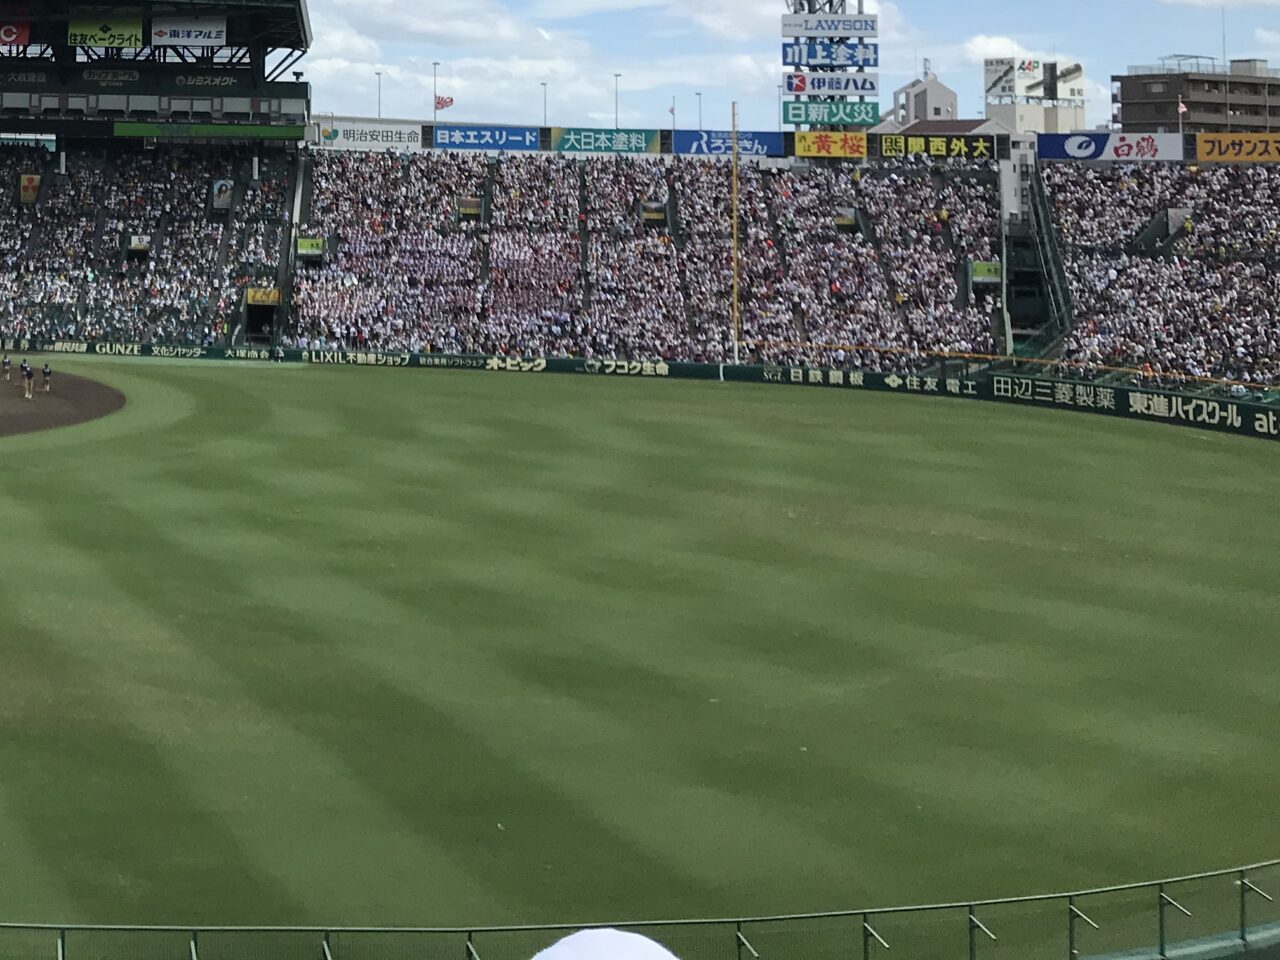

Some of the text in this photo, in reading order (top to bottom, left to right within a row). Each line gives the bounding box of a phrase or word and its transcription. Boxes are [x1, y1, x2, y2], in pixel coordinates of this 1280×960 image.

[169, 29, 225, 40] 東洋アルミ
[804, 20, 876, 31] LAWSON
[69, 32, 141, 46] 住友ベークライト
[785, 44, 877, 65] 川上塗料
[810, 77, 876, 91] 伊藤ハム
[788, 103, 874, 122] 日新火災
[342, 129, 420, 144] 明治安田生命
[436, 128, 537, 146] 日本エスリード
[564, 131, 647, 152] 大日本塗料
[710, 139, 768, 155] ろうきん
[1113, 135, 1159, 158] 白鶴
[96, 343, 141, 355] GUNZE
[151, 346, 207, 358] 文化シャッター
[604, 358, 670, 376] フコク生命
[906, 375, 978, 395] 住友電工
[993, 376, 1116, 411] 田辺三菱製薬
[1128, 392, 1242, 428] 東進ハイスクール
[1254, 411, 1279, 435] at
